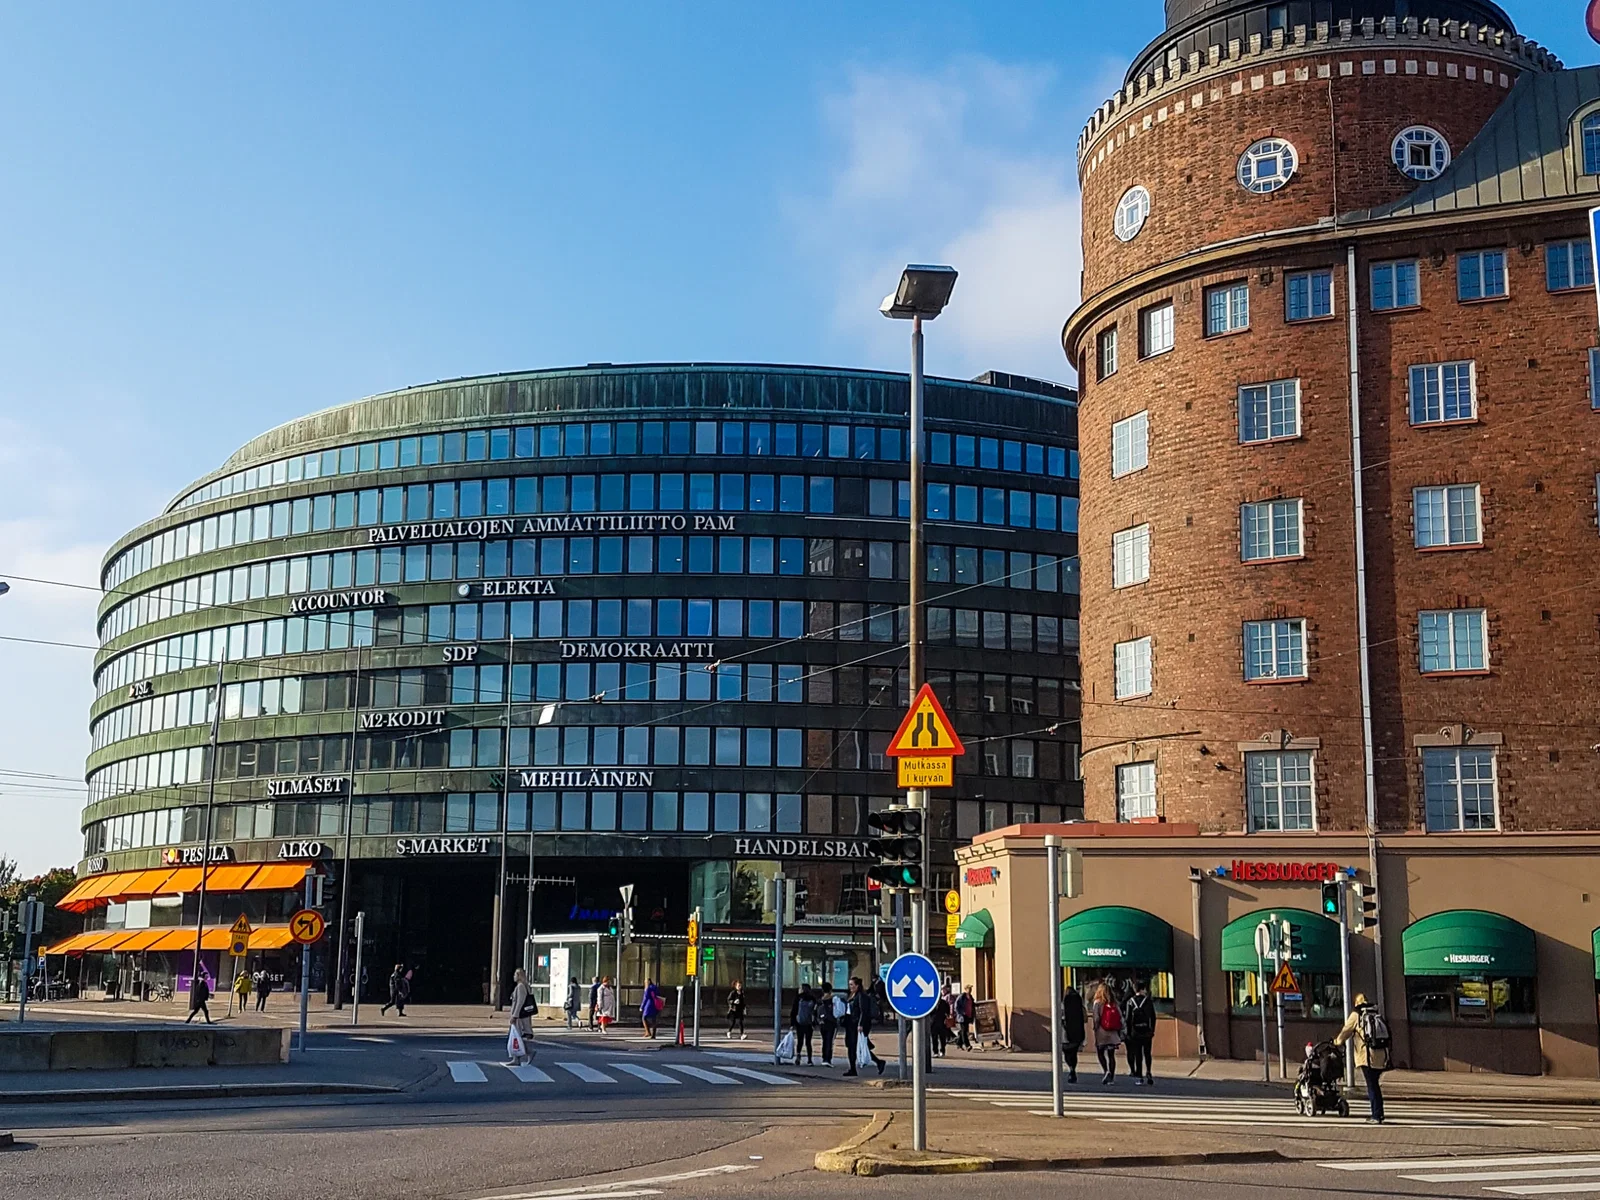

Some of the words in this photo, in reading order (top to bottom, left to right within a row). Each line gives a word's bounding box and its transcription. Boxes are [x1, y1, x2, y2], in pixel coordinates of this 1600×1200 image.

[367, 519, 515, 543] PALVELUALOJEN
[522, 515, 687, 534] AMMATTILIITTO
[693, 515, 736, 531] PAM
[482, 580, 556, 596] ELEKTA
[288, 589, 386, 613] ACCOUNTOR
[442, 645, 478, 663] SDP
[561, 642, 715, 659] DEMOKRAATTI
[134, 680, 149, 696] TSL
[360, 710, 445, 729] M2-KODIT
[904, 761, 946, 770] Mutkassa
[266, 776, 344, 796] SILMÄSET
[519, 769, 654, 788] MEHILÄINEN
[914, 774, 944, 783] kurvan
[277, 841, 321, 859] ALKO
[397, 837, 491, 854] S-MARKET
[734, 838, 877, 859] HANDELSBAN
[162, 848, 180, 864] SOL
[1231, 859, 1340, 881] HESBURGER
[1087, 948, 1122, 957] HESBURGER
[1449, 954, 1490, 964] HESBURGER
